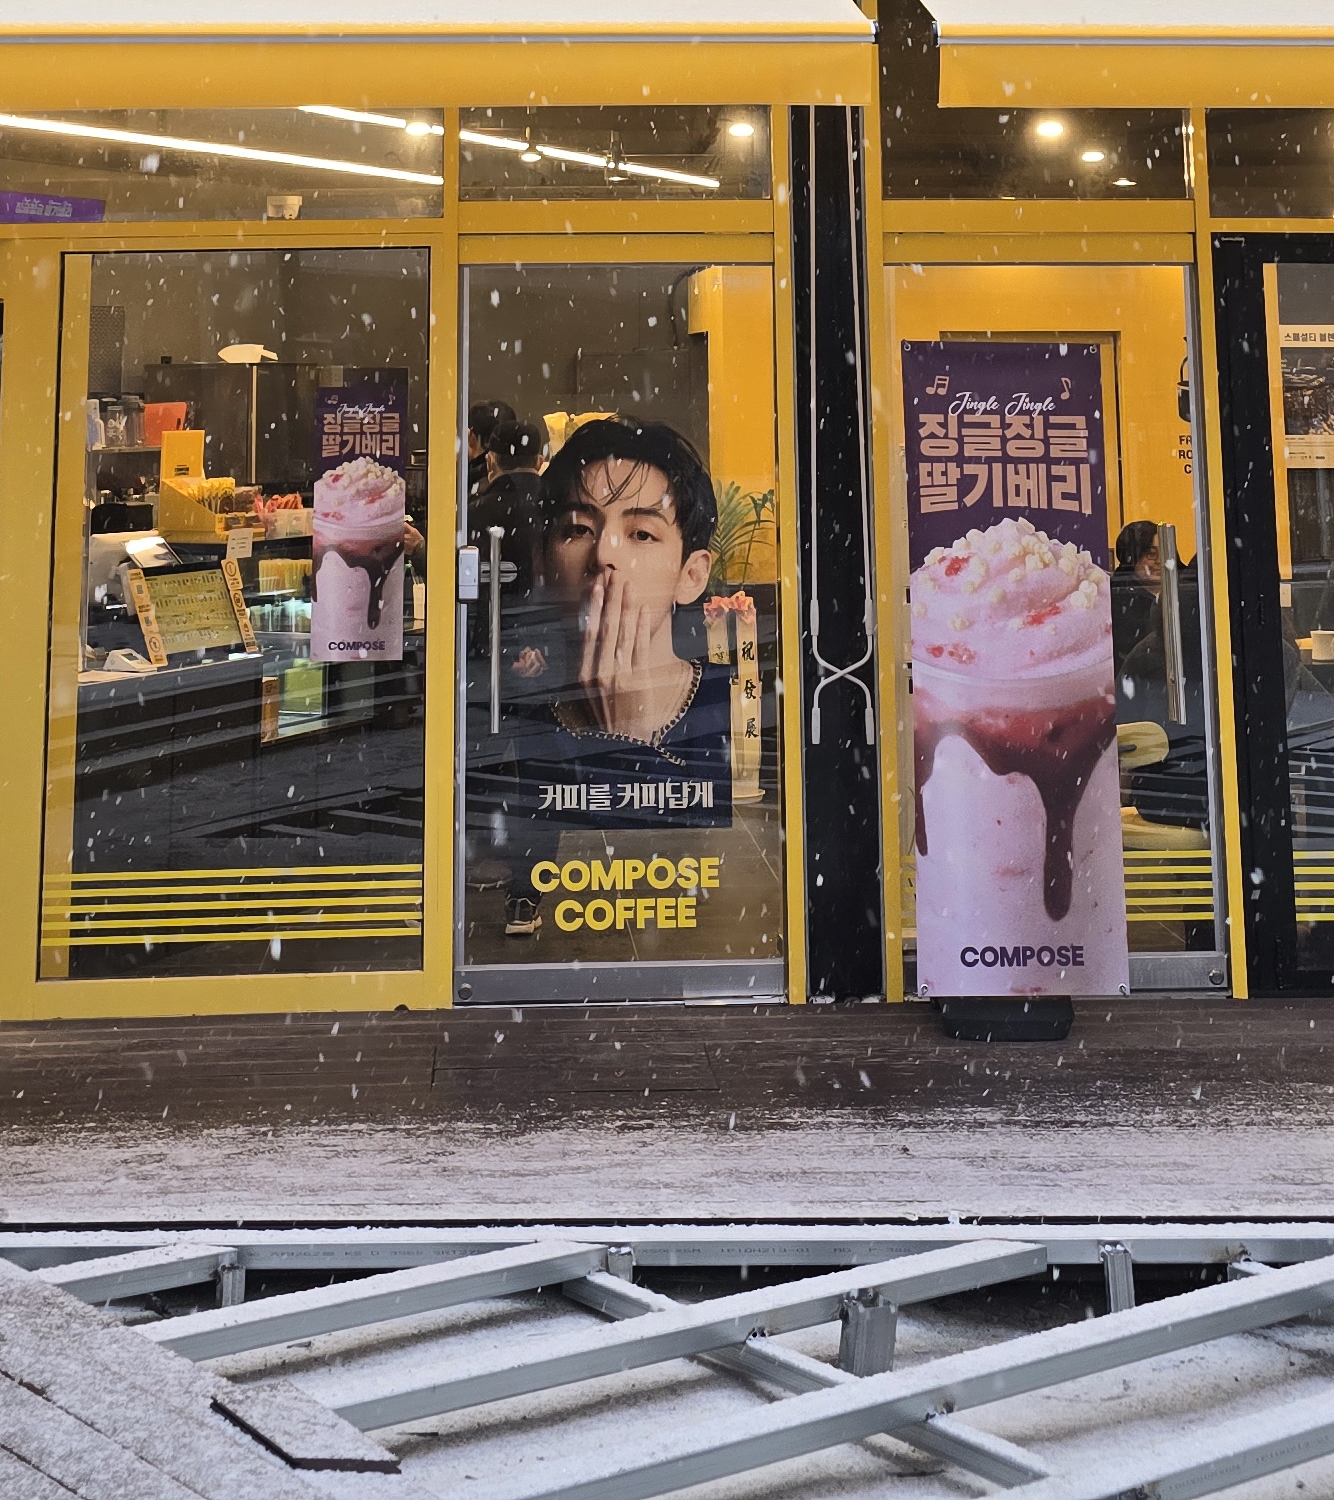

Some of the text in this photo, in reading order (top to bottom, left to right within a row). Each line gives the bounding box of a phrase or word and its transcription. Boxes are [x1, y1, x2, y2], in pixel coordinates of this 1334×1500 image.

[948, 391, 1056, 417] Jingle Jingle
[323, 412, 400, 433] 징글징글
[918, 412, 1089, 458] 징글징글
[322, 434, 400, 458] 딸기베리
[918, 462, 1093, 515] 딸기베리
[328, 640, 386, 651] COMPOSE
[538, 781, 714, 813] 커피를 커피답게
[530, 857, 721, 893] COMPOSE
[554, 899, 698, 933] COFFEE
[960, 944, 1085, 968] COMPOSE
